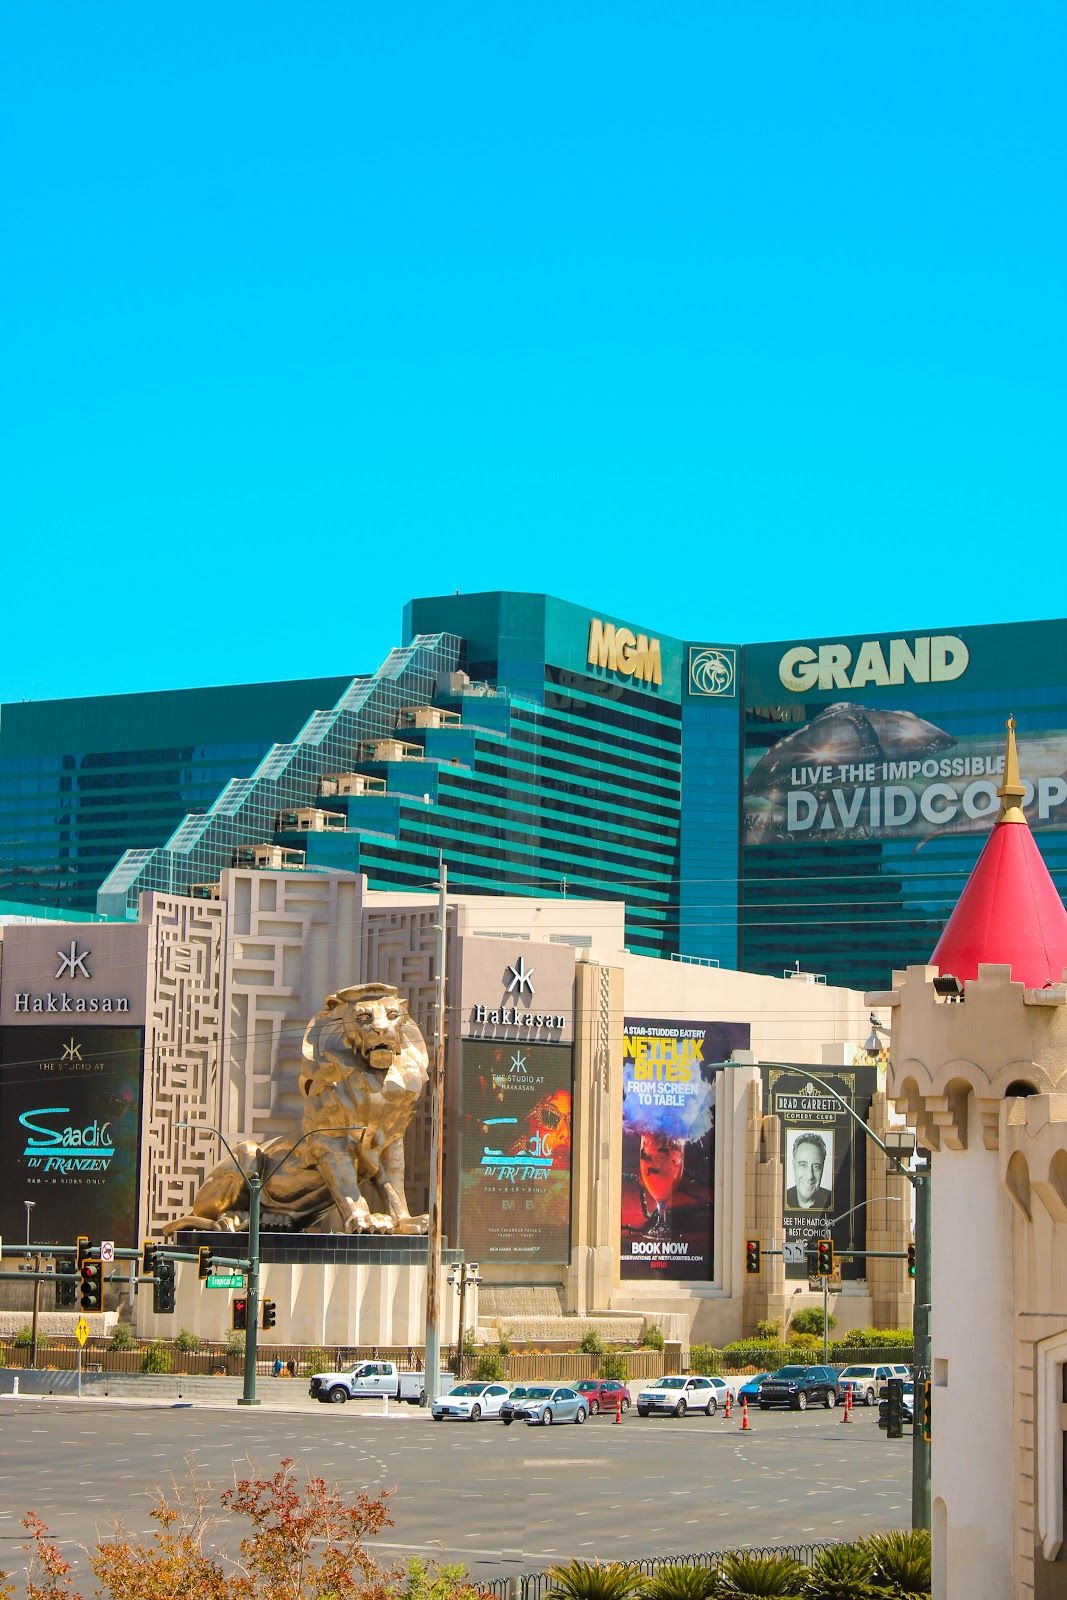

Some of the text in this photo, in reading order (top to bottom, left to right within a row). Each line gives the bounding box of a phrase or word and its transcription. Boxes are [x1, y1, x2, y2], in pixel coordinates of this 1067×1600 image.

[587, 618, 663, 685] MGM
[778, 635, 970, 692] GRAND
[791, 756, 1005, 785] LIVE THE IMPOSSIBLE
[14, 992, 129, 1012] Hakkasan
[475, 1004, 566, 1029] Hakkasan
[623, 1026, 706, 1038] A STAR-STUDDED EATERY
[623, 1035, 705, 1062] NETFLIX
[507, 1074, 534, 1083] STUDIO
[634, 1058, 692, 1083] BITES
[627, 1081, 698, 1096] FROM SCREEN
[638, 1093, 686, 1107] TO TABLE
[779, 1097, 842, 1111] BRAD GARRETT'S
[28, 1157, 111, 1175] DJ FRANZEN
[783, 1217, 793, 1226] SEE
[794, 1217, 805, 1226] THE
[789, 1228, 801, 1236] BEST
[631, 1242, 689, 1255] BOOK NOW
